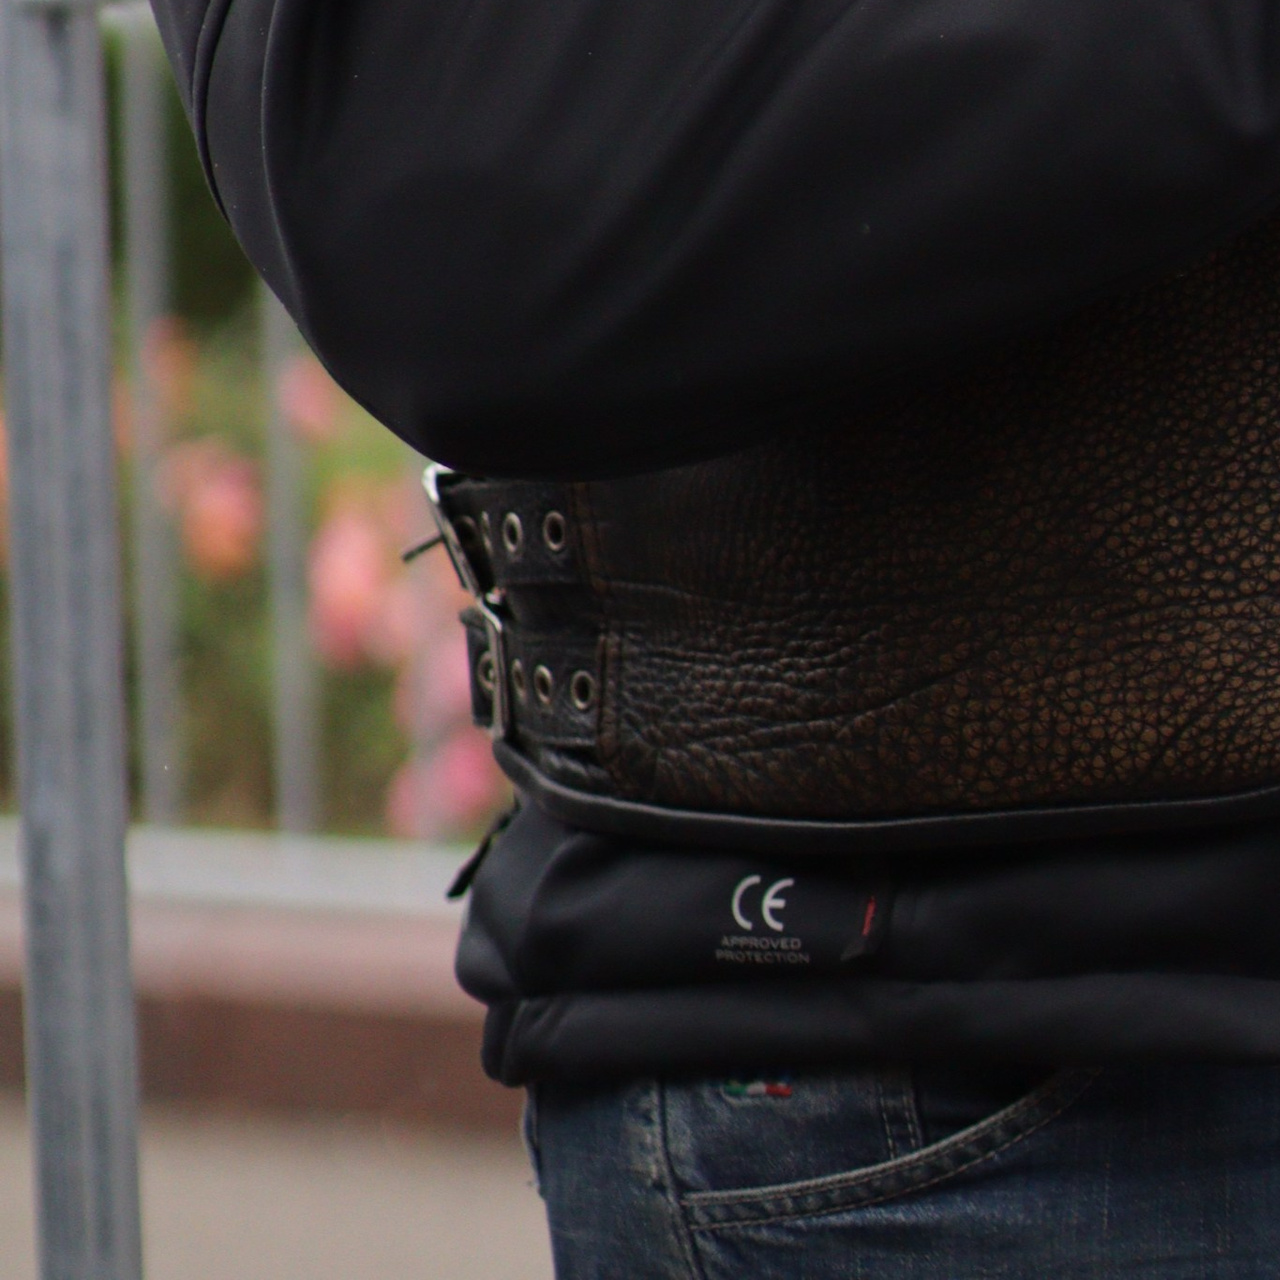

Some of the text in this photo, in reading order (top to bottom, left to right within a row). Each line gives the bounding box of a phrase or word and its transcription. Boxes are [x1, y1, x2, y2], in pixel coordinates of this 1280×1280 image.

[732, 875, 793, 931] CE
[721, 936, 801, 950] APPROVED
[716, 949, 809, 963] PROTECTION
